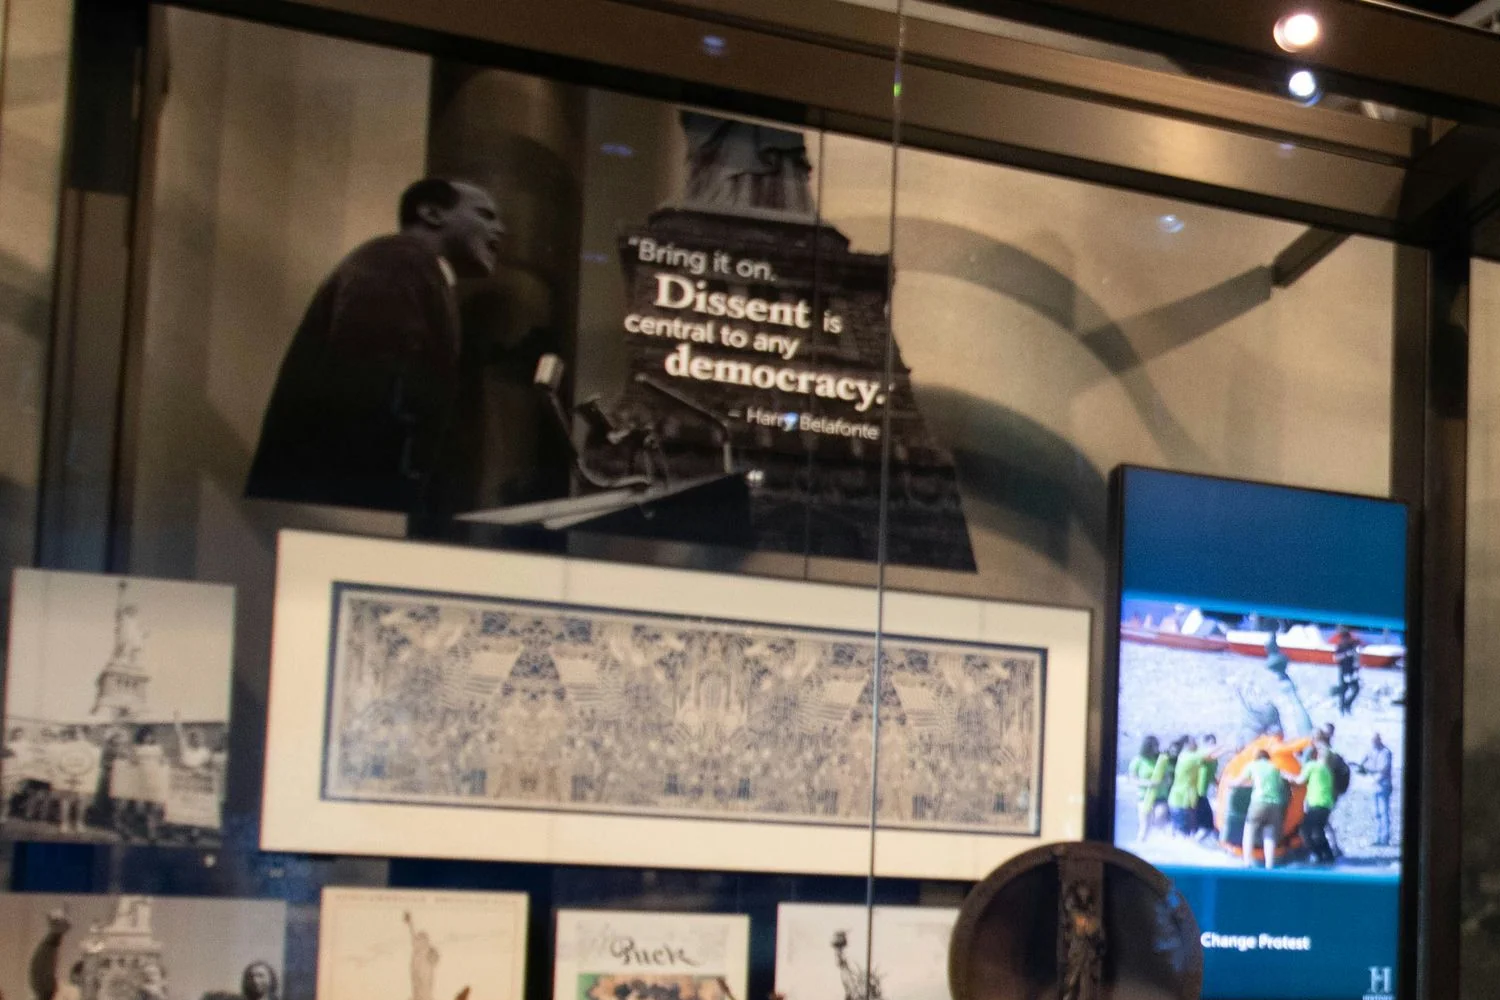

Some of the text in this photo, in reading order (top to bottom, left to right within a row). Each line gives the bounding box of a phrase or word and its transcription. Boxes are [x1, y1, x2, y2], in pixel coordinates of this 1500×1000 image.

[713, 250, 730, 273] it
[736, 259, 777, 283] on.
[654, 272, 843, 334] Dissent is
[624, 313, 799, 360] central to any
[747, 407, 797, 432] Harry
[799, 416, 880, 440] Belafonte
[1200, 931, 1310, 951] Change Protest
[1368, 966, 1391, 993] H
